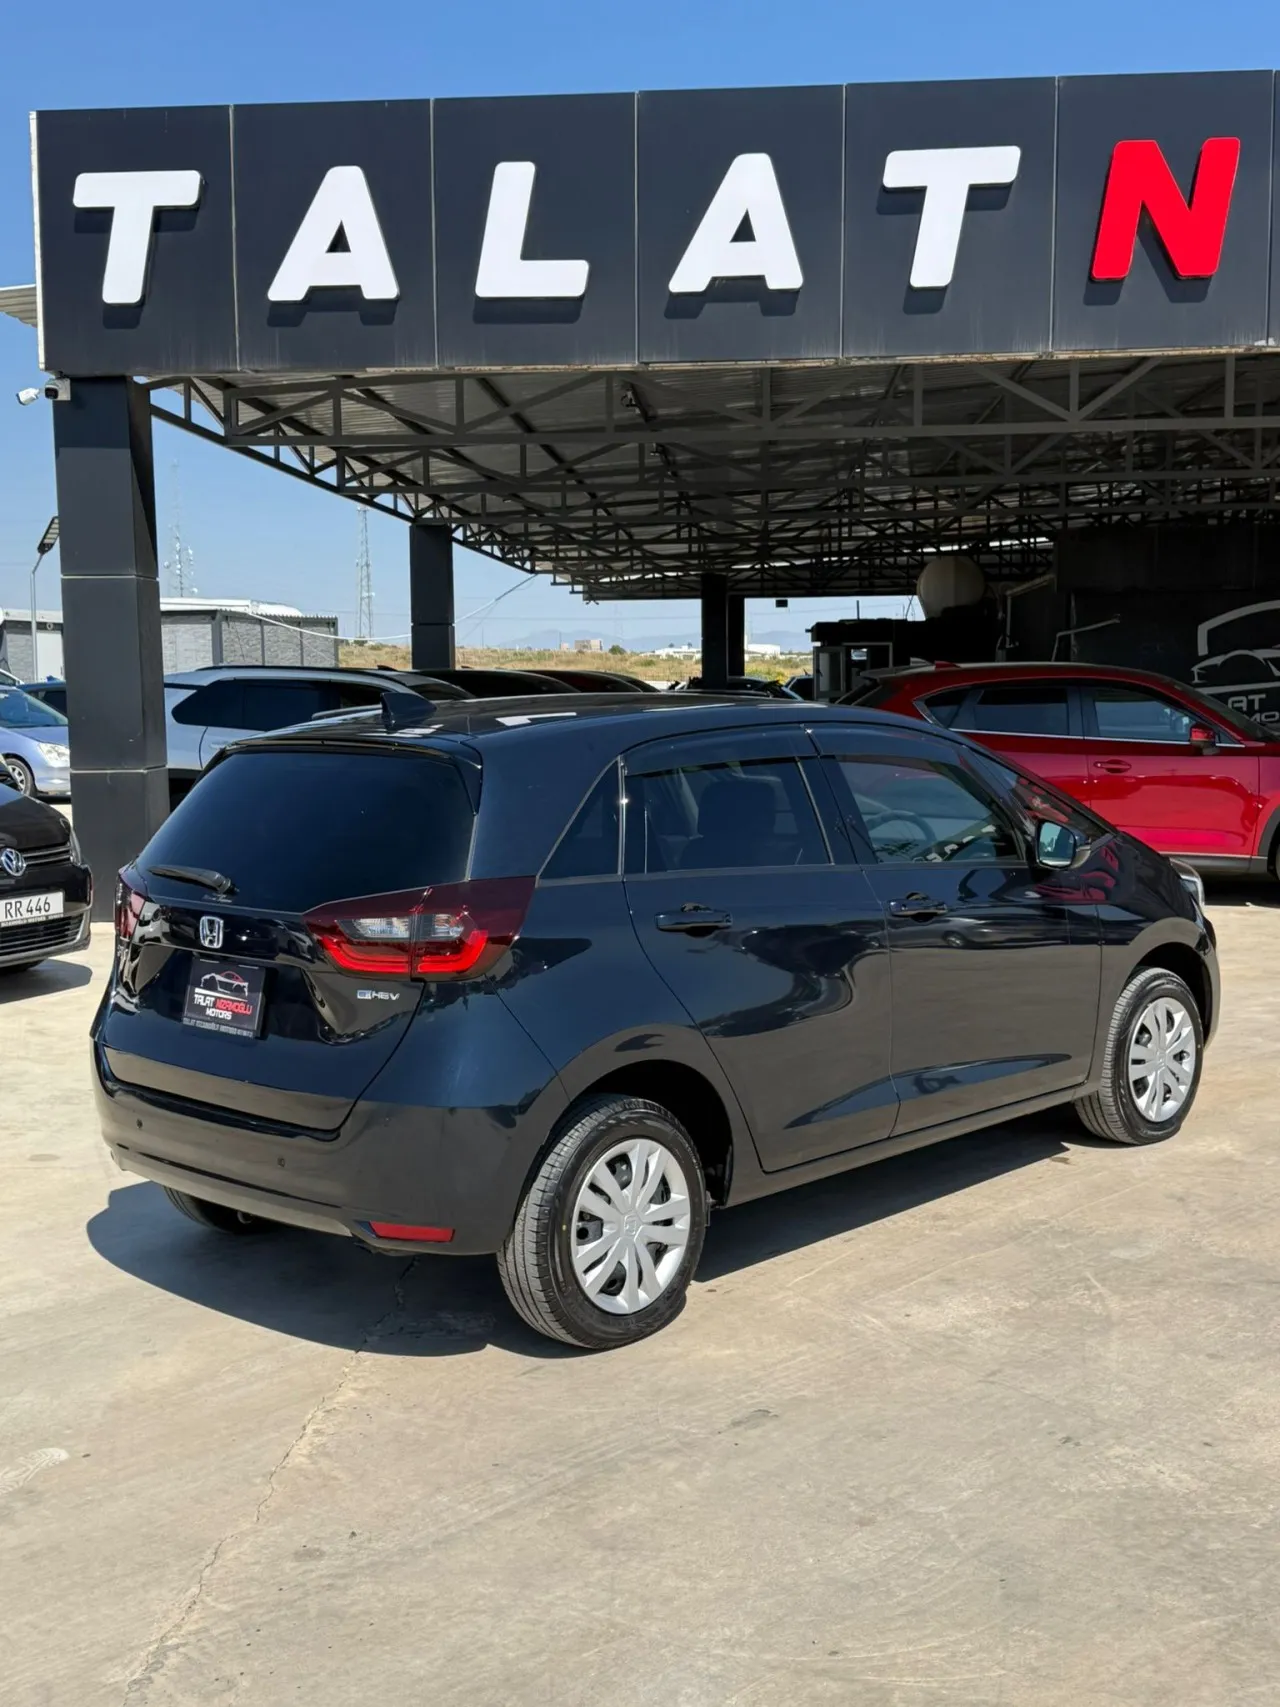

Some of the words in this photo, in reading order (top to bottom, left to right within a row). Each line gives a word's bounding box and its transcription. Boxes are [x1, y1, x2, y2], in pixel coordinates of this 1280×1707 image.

[4, 901, 23, 919] RR
[26, 896, 51, 914] 446
[194, 994, 215, 1007] TALAT
[205, 1008, 232, 1020] MOTORS
